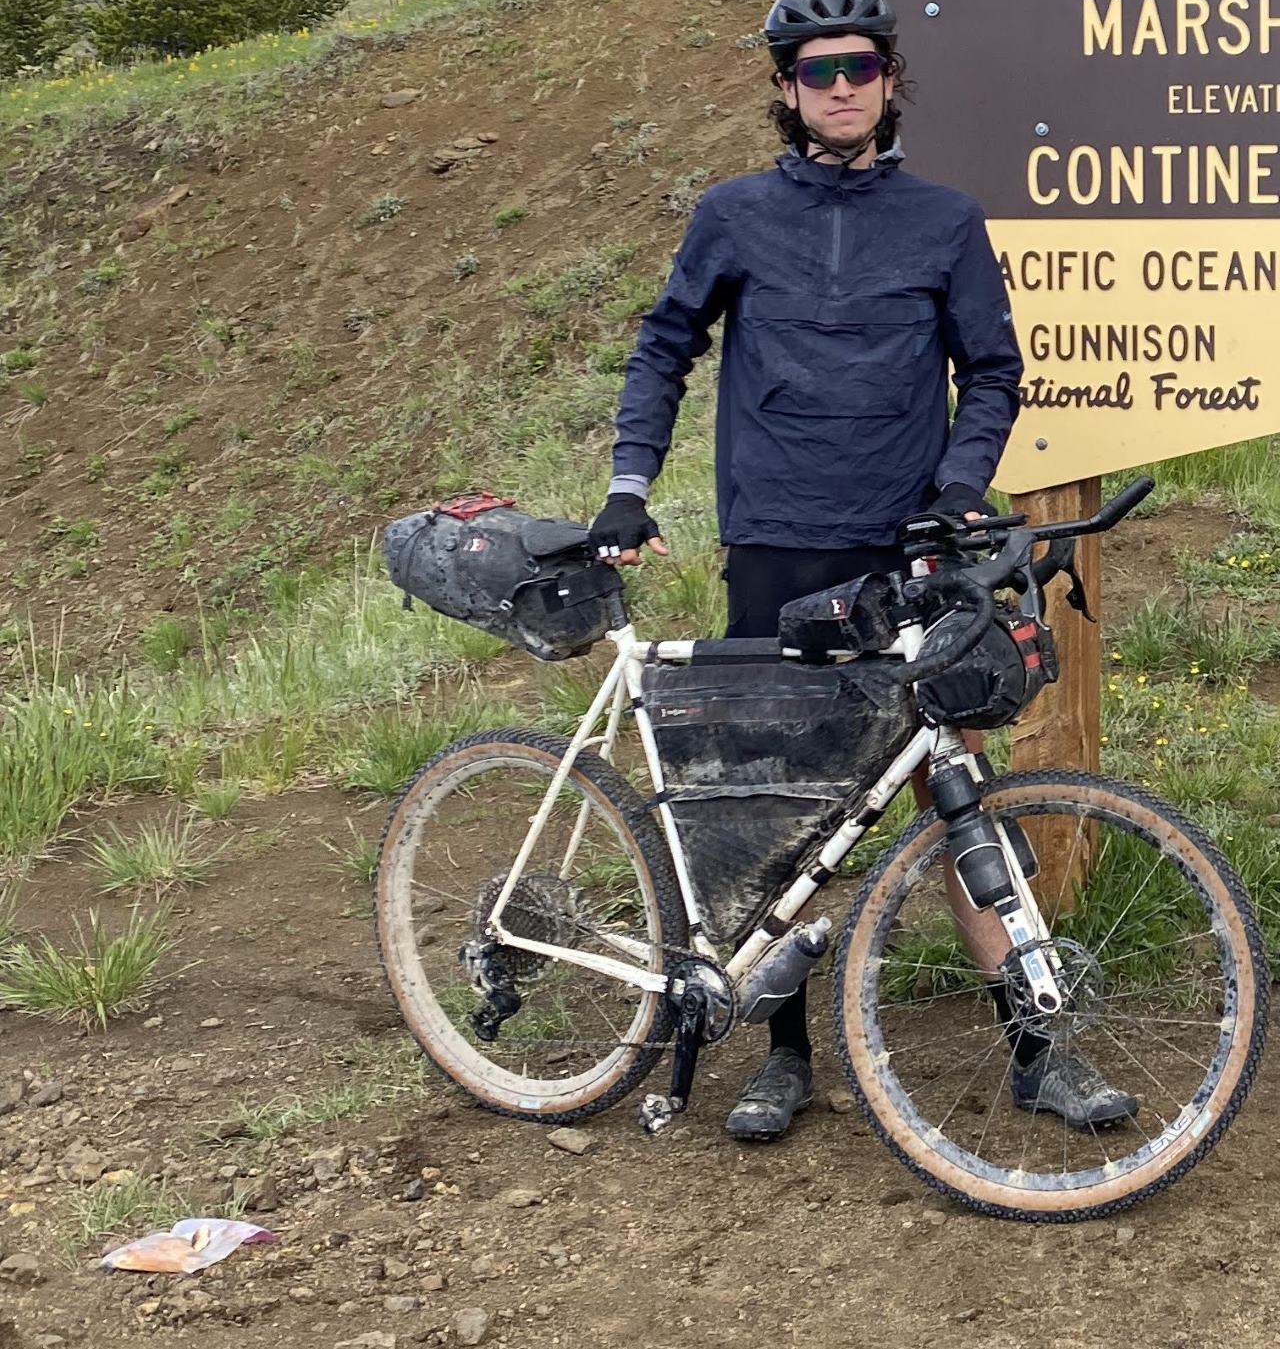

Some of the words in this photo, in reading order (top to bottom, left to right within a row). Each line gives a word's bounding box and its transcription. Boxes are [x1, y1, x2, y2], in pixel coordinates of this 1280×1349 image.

[999, 250, 1115, 291] ACIFIC
[1142, 250, 1276, 292] OCEAN
[1030, 323, 1215, 362] GUNNISON
[1018, 371, 1134, 411] ational
[1149, 372, 1261, 411] Forest
